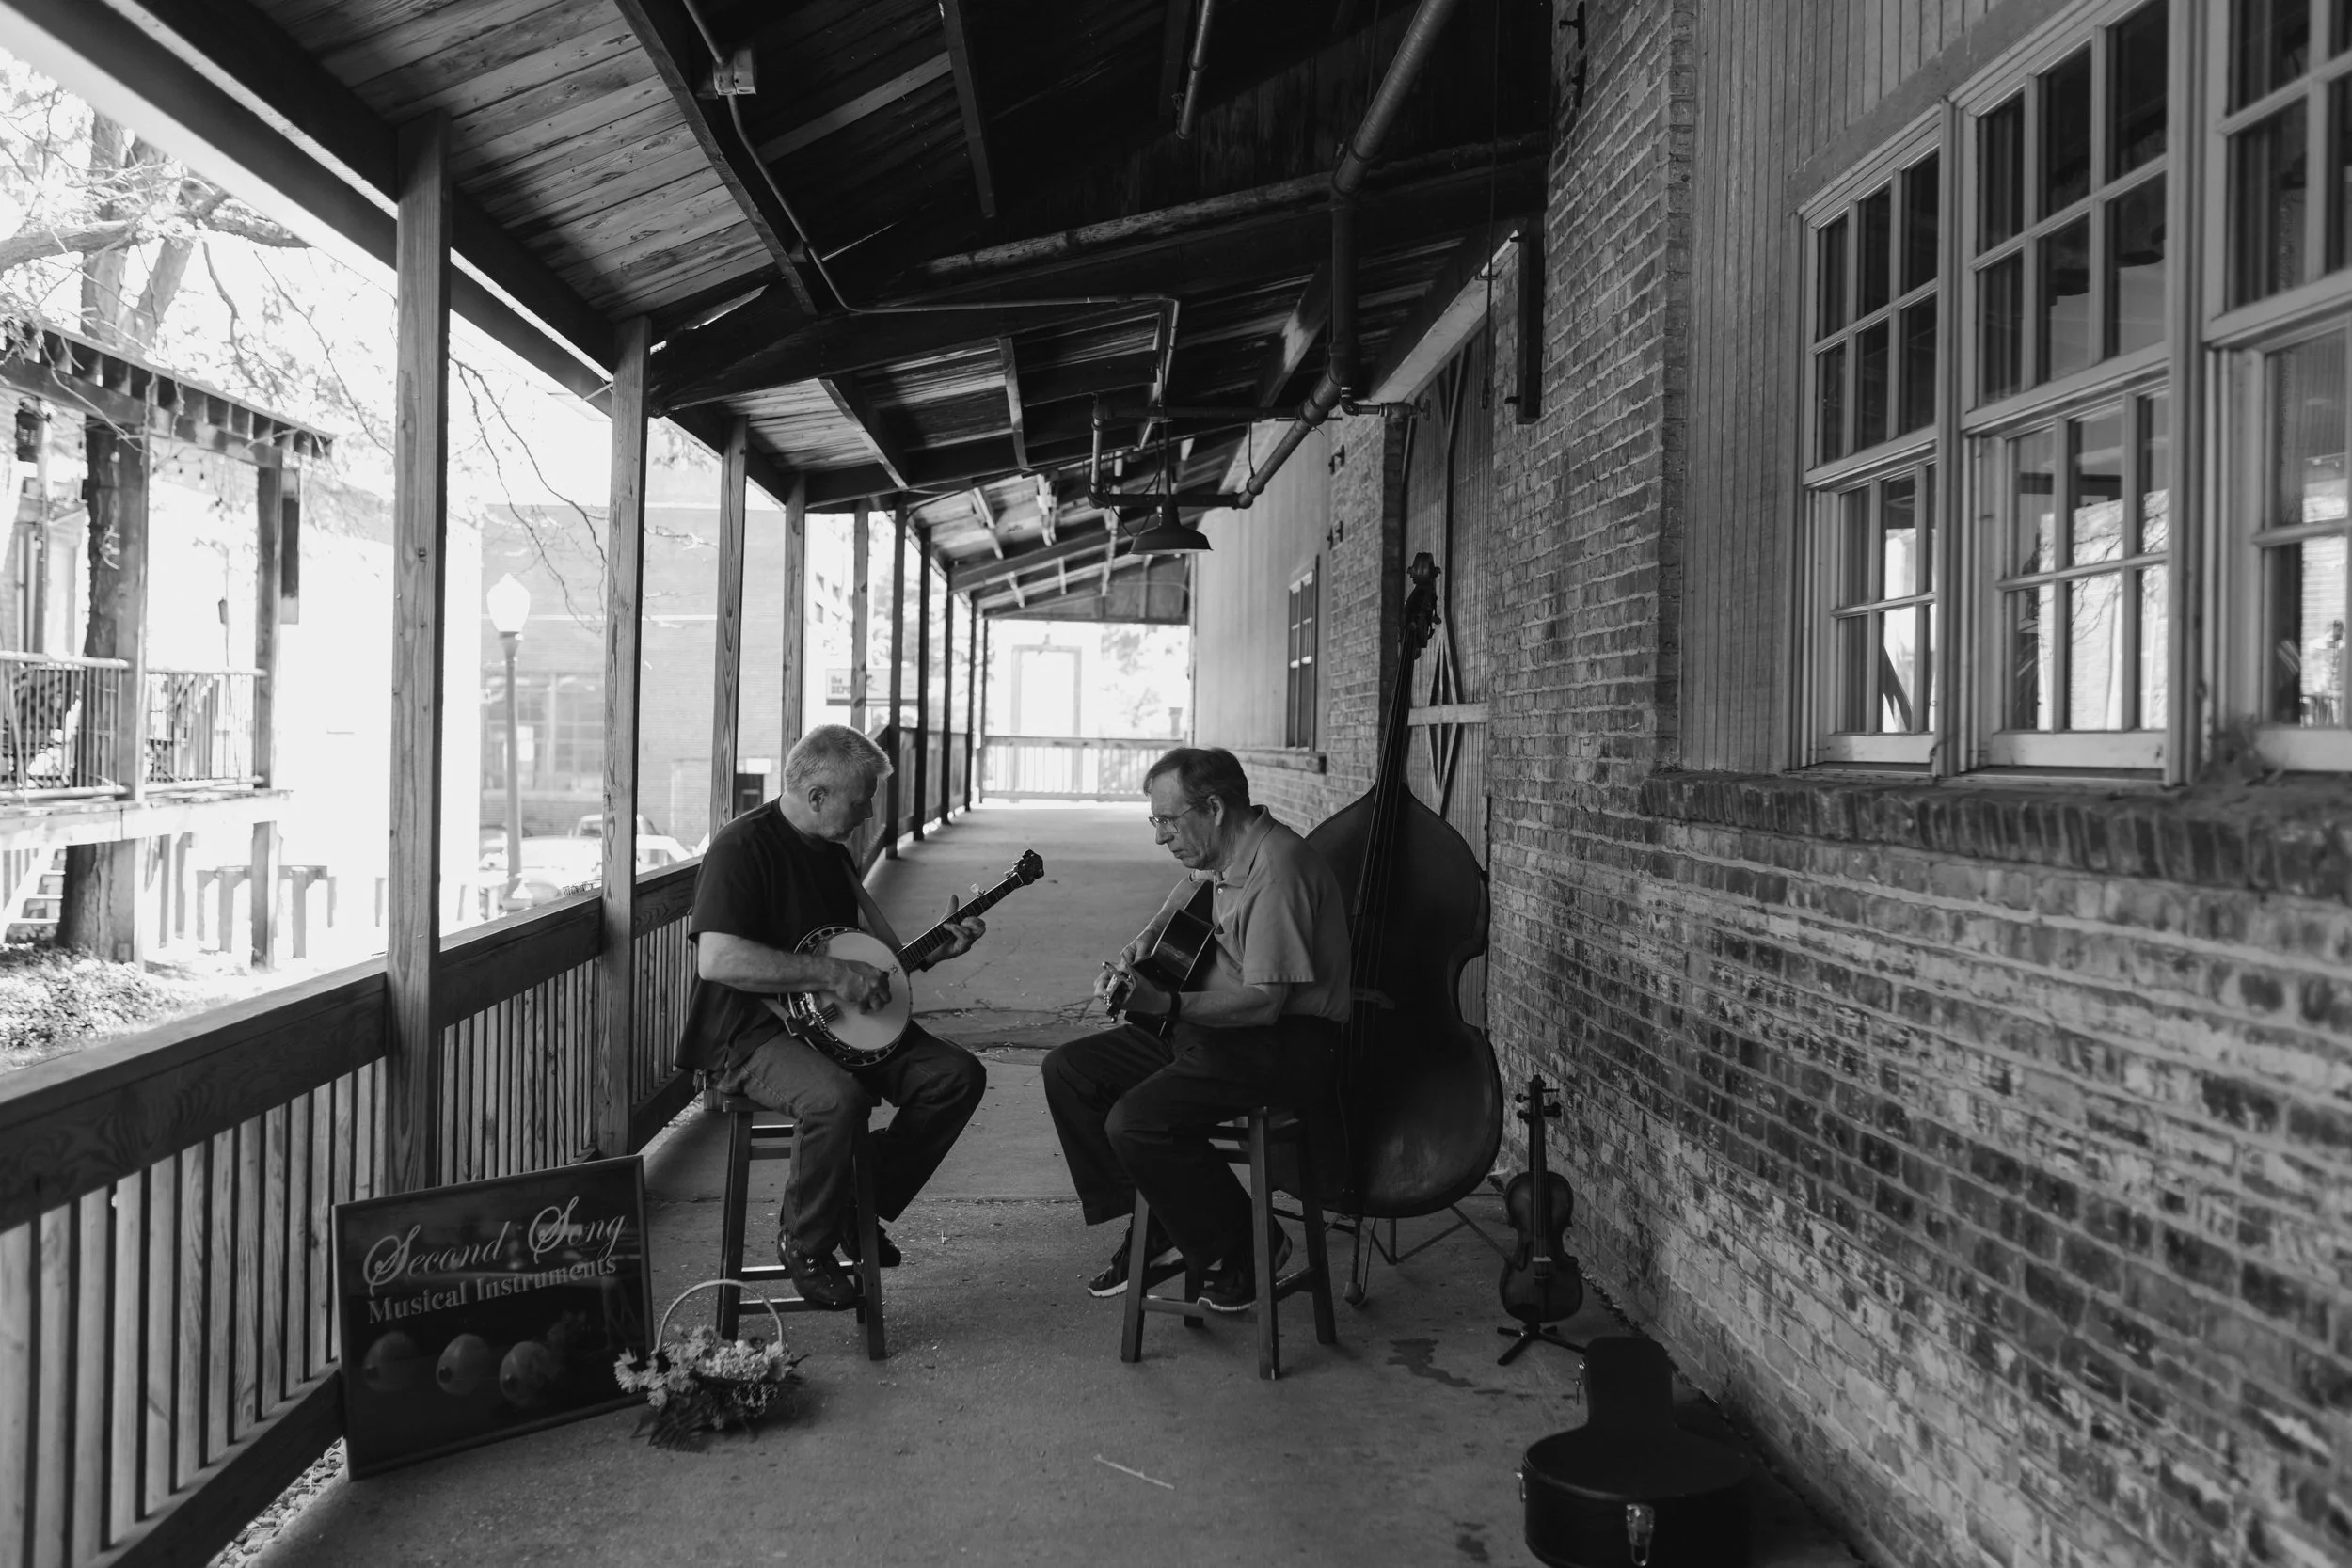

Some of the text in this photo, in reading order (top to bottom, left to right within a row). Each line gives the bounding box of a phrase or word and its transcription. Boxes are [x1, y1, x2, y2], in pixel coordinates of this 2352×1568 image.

[363, 1196, 627, 1297] Second Song
[368, 1257, 617, 1323] Musical Instruments
